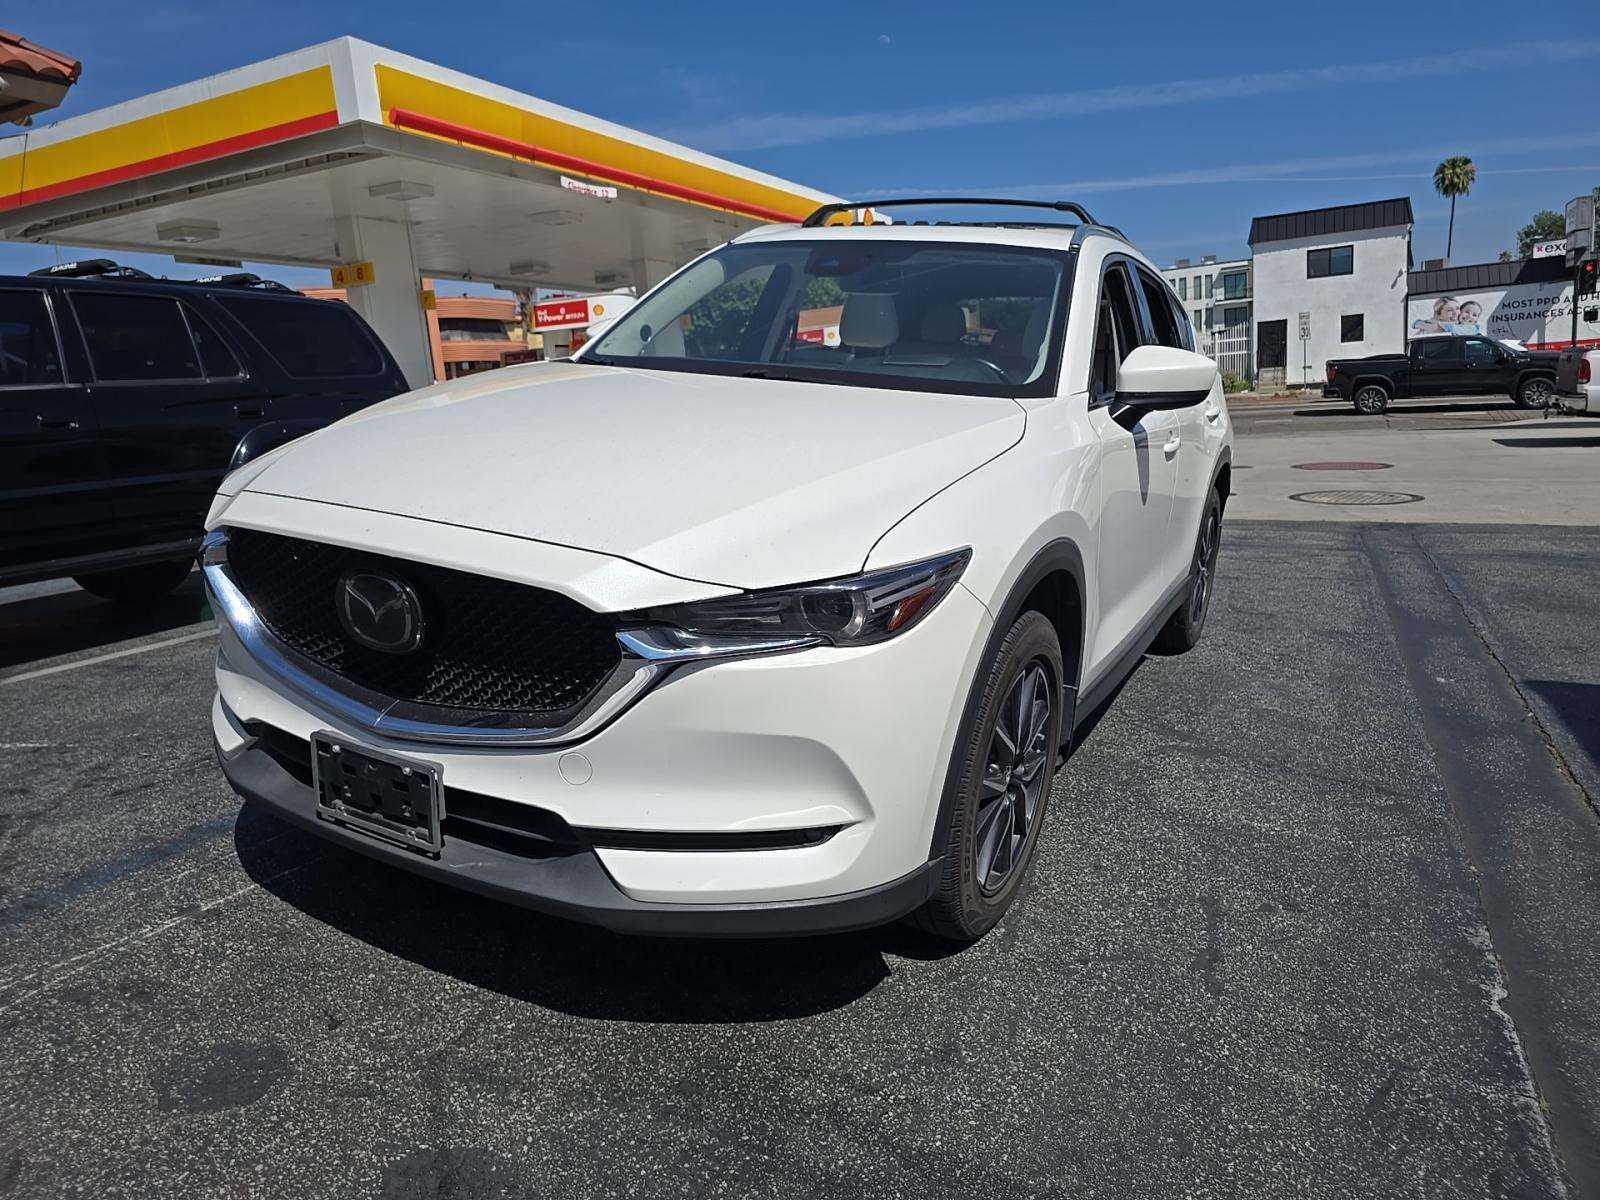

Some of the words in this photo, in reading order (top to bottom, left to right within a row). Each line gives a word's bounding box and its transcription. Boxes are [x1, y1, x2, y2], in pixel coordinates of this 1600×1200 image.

[336, 270, 344, 283] 4
[356, 267, 364, 281] 8
[1501, 299, 1533, 310] MOST
[1536, 295, 1560, 306] PPO
[1563, 291, 1588, 303] AD
[1491, 308, 1564, 323] INSURANCES
